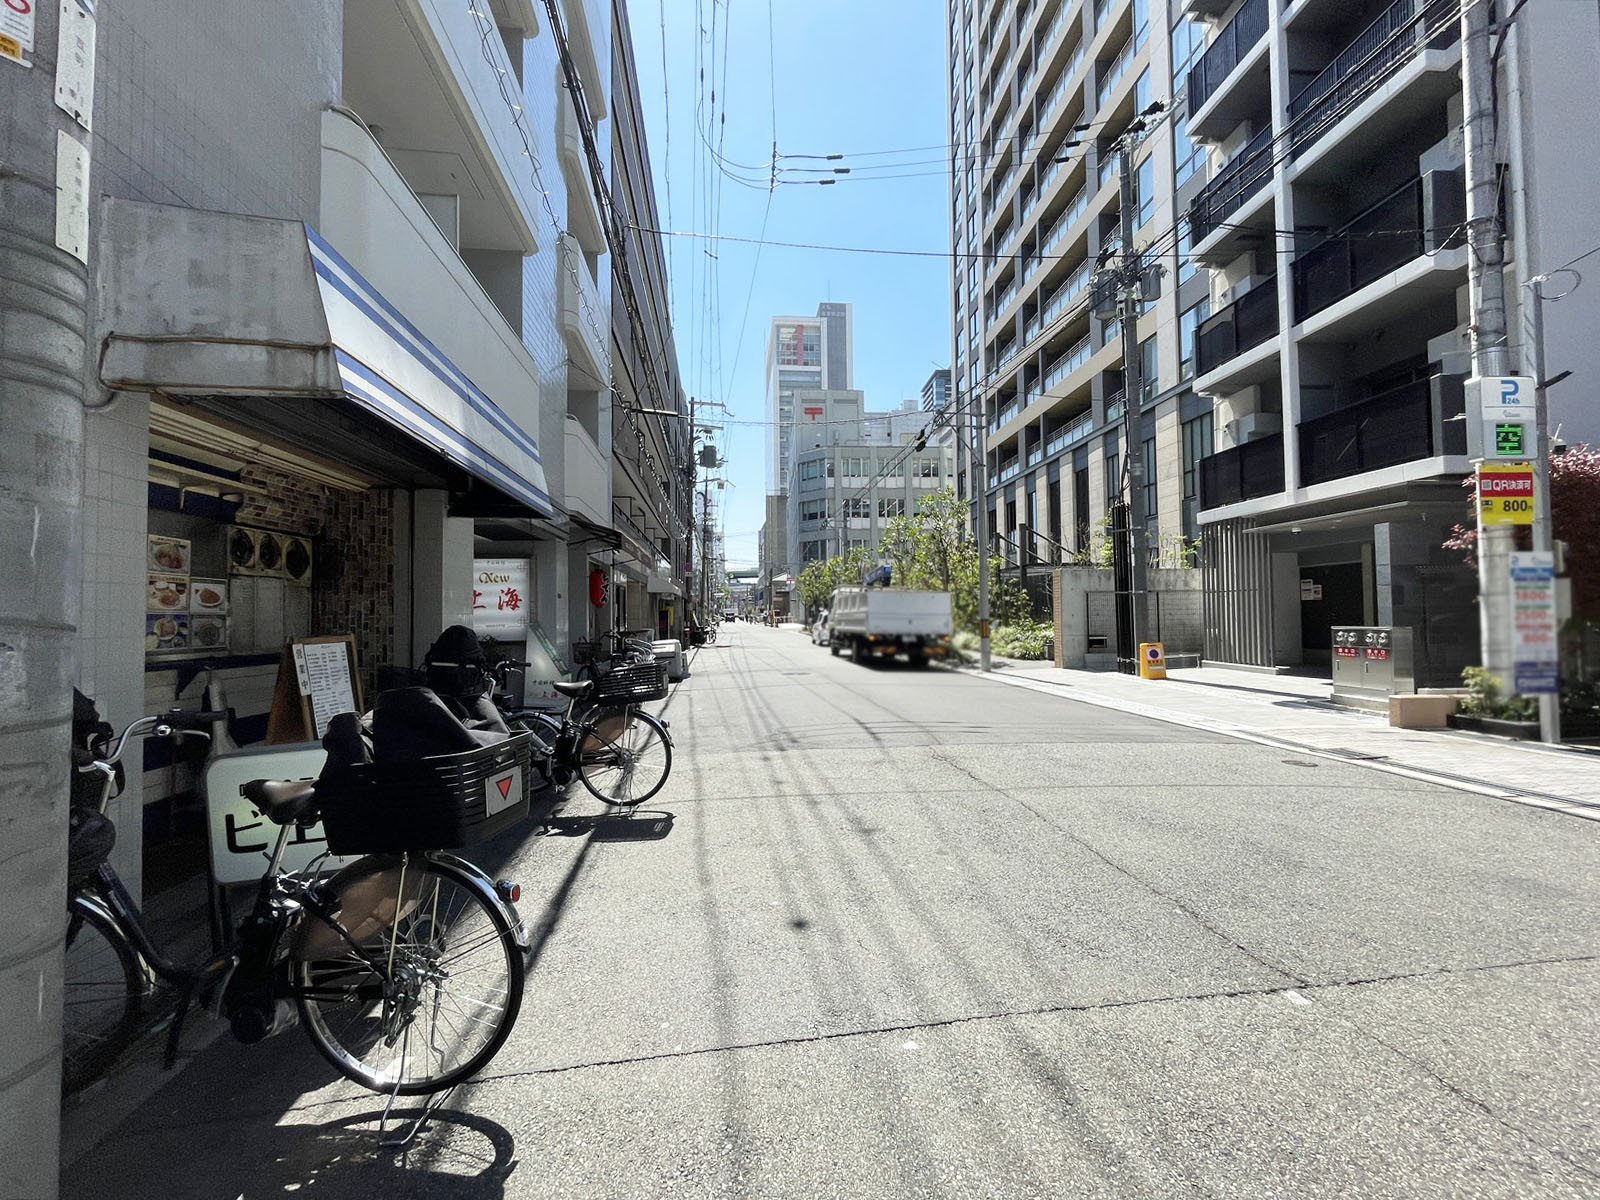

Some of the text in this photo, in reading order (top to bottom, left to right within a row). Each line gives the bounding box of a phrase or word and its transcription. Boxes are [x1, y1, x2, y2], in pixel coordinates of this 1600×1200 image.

[1493, 479, 1531, 491] QR決済可
[479, 572, 510, 584] New
[473, 588, 523, 611] 上海
